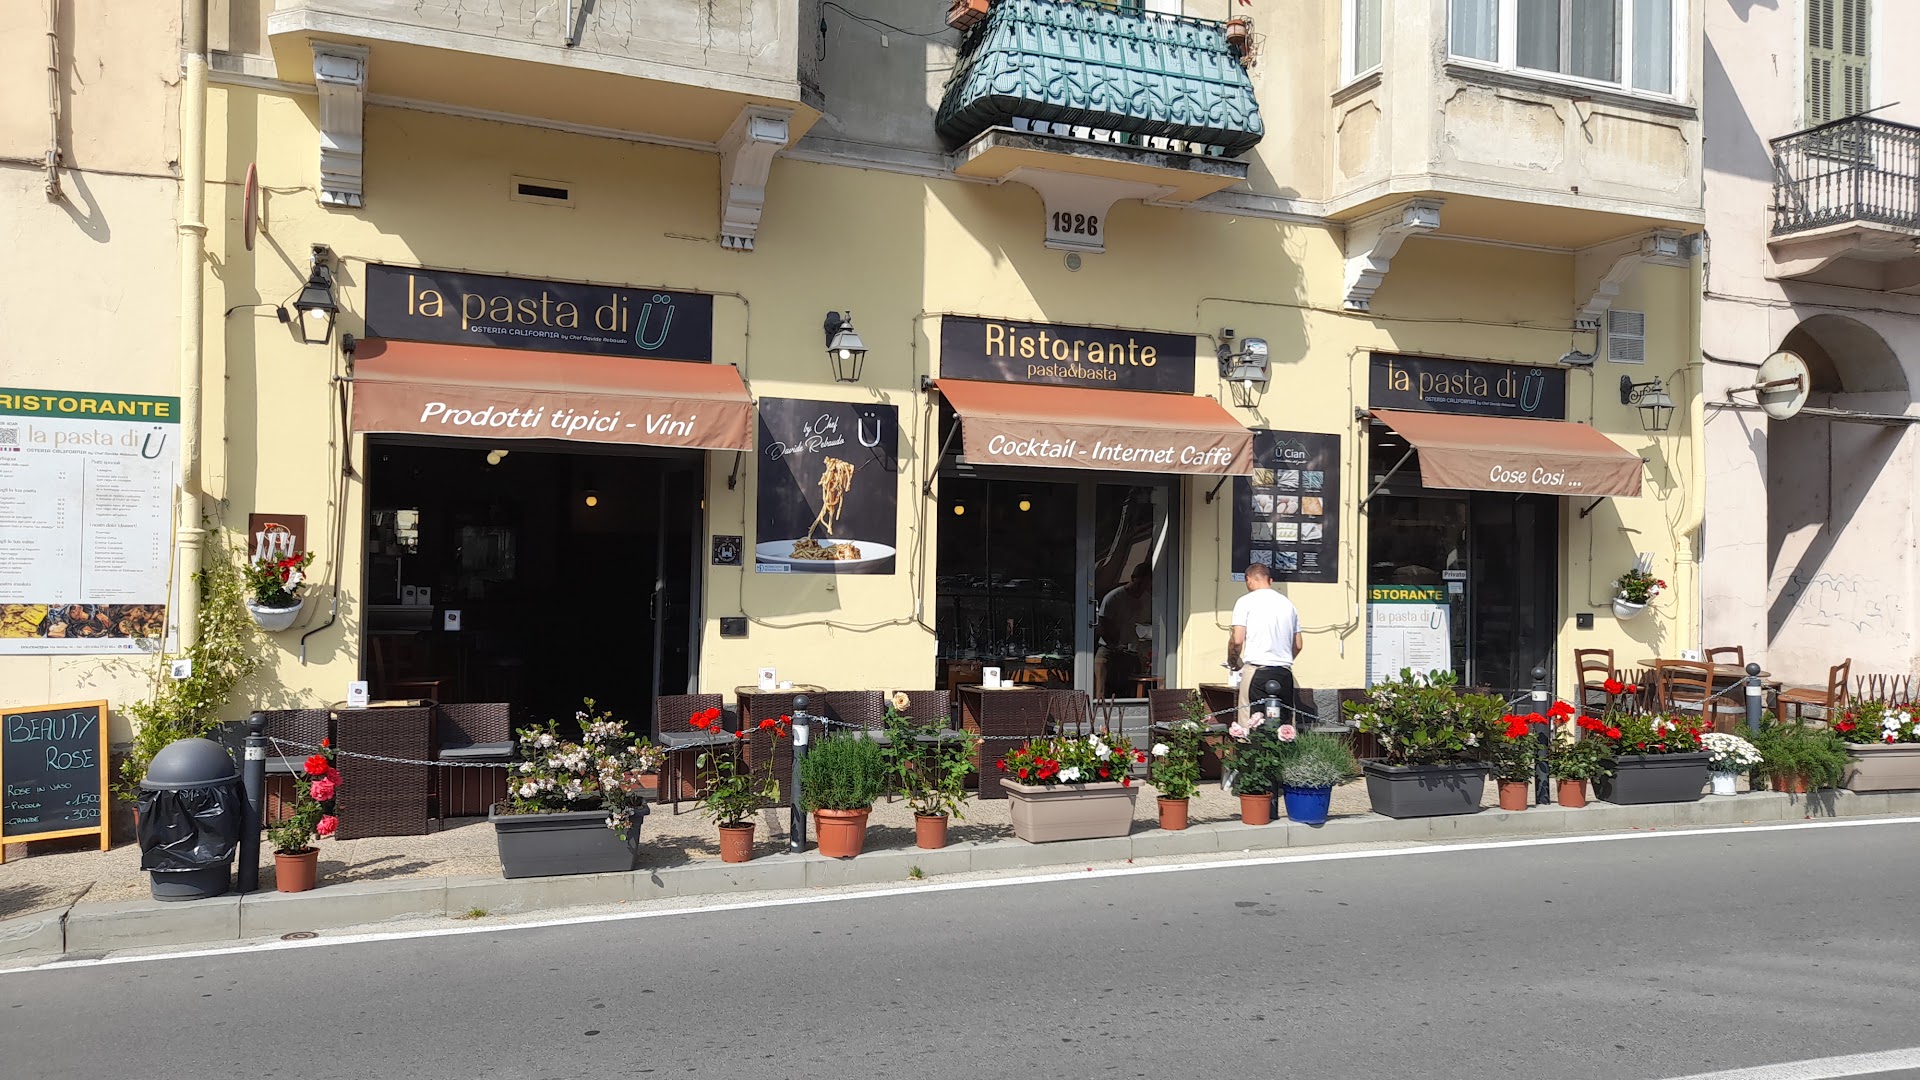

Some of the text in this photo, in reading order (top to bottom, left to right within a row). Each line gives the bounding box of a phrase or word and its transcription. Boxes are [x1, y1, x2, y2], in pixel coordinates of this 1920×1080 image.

[1052, 211, 1098, 236] 1926
[407, 274, 676, 351] la pasta di Ü
[470, 325, 507, 334] OSTERIA
[508, 327, 560, 339] CALIFORNIA
[985, 322, 1157, 367] Ristorante
[1026, 362, 1118, 381] pasta&basta
[1387, 359, 1545, 413] la pasta di Ü
[0, 394, 170, 417] RISTORANTE
[419, 401, 543, 428] Prodotti
[549, 406, 621, 436] tipici
[643, 413, 698, 437] Vini
[802, 413, 840, 438] by Chef
[857, 411, 881, 448] Ü
[28, 424, 167, 460] la pasta di Ü
[764, 434, 846, 461] Davide Rebaudo
[987, 434, 1076, 459] Cocktail
[1091, 441, 1175, 464] Internet
[1179, 445, 1233, 467] Caffè
[1284, 448, 1305, 459] Cian
[1489, 465, 1527, 483] Cose
[1366, 589, 1444, 600] ISTORANTE
[1376, 609, 1386, 622] la
[1388, 610, 1418, 624] pasta
[1420, 609, 1429, 622] di
[8, 711, 97, 743] BEAUTY
[45, 745, 95, 772] ROSE
[7, 784, 31, 797] ROSE
[36, 786, 46, 794] IN
